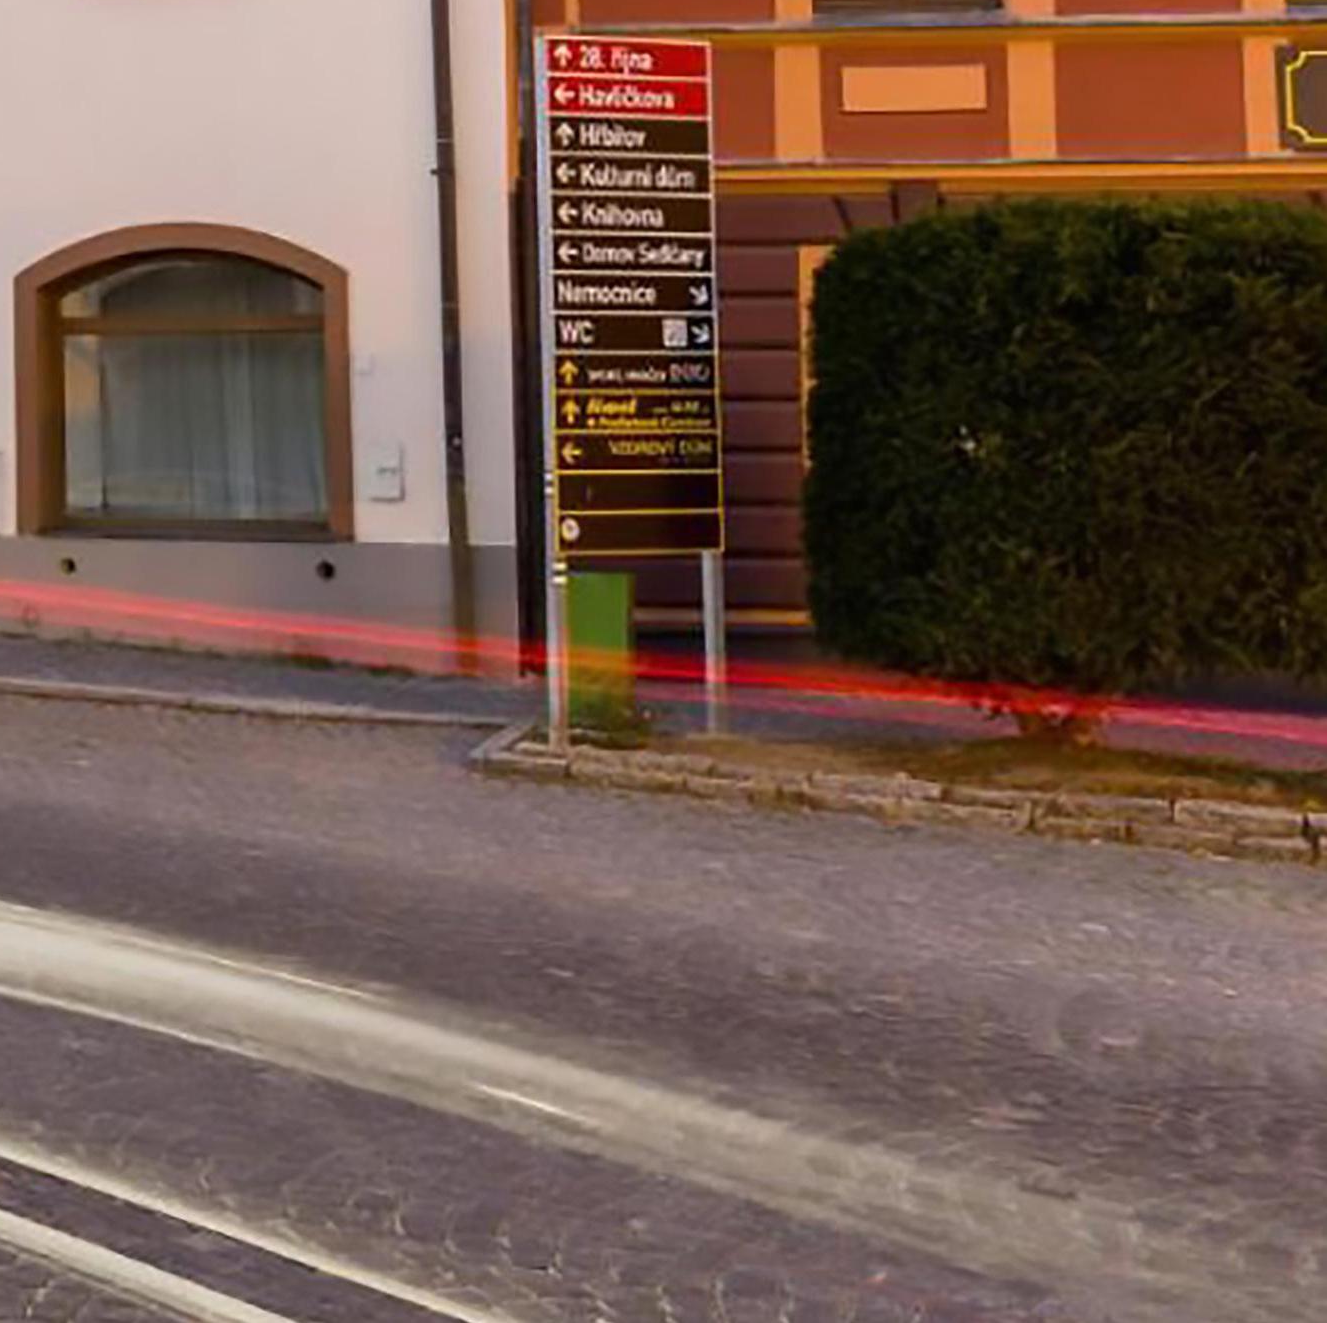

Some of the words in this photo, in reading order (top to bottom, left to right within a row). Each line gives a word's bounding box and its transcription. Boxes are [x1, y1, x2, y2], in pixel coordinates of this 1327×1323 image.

[581, 202, 664, 227] Knihovna
[557, 281, 657, 303] Nemocnice
[558, 319, 594, 344] WC
